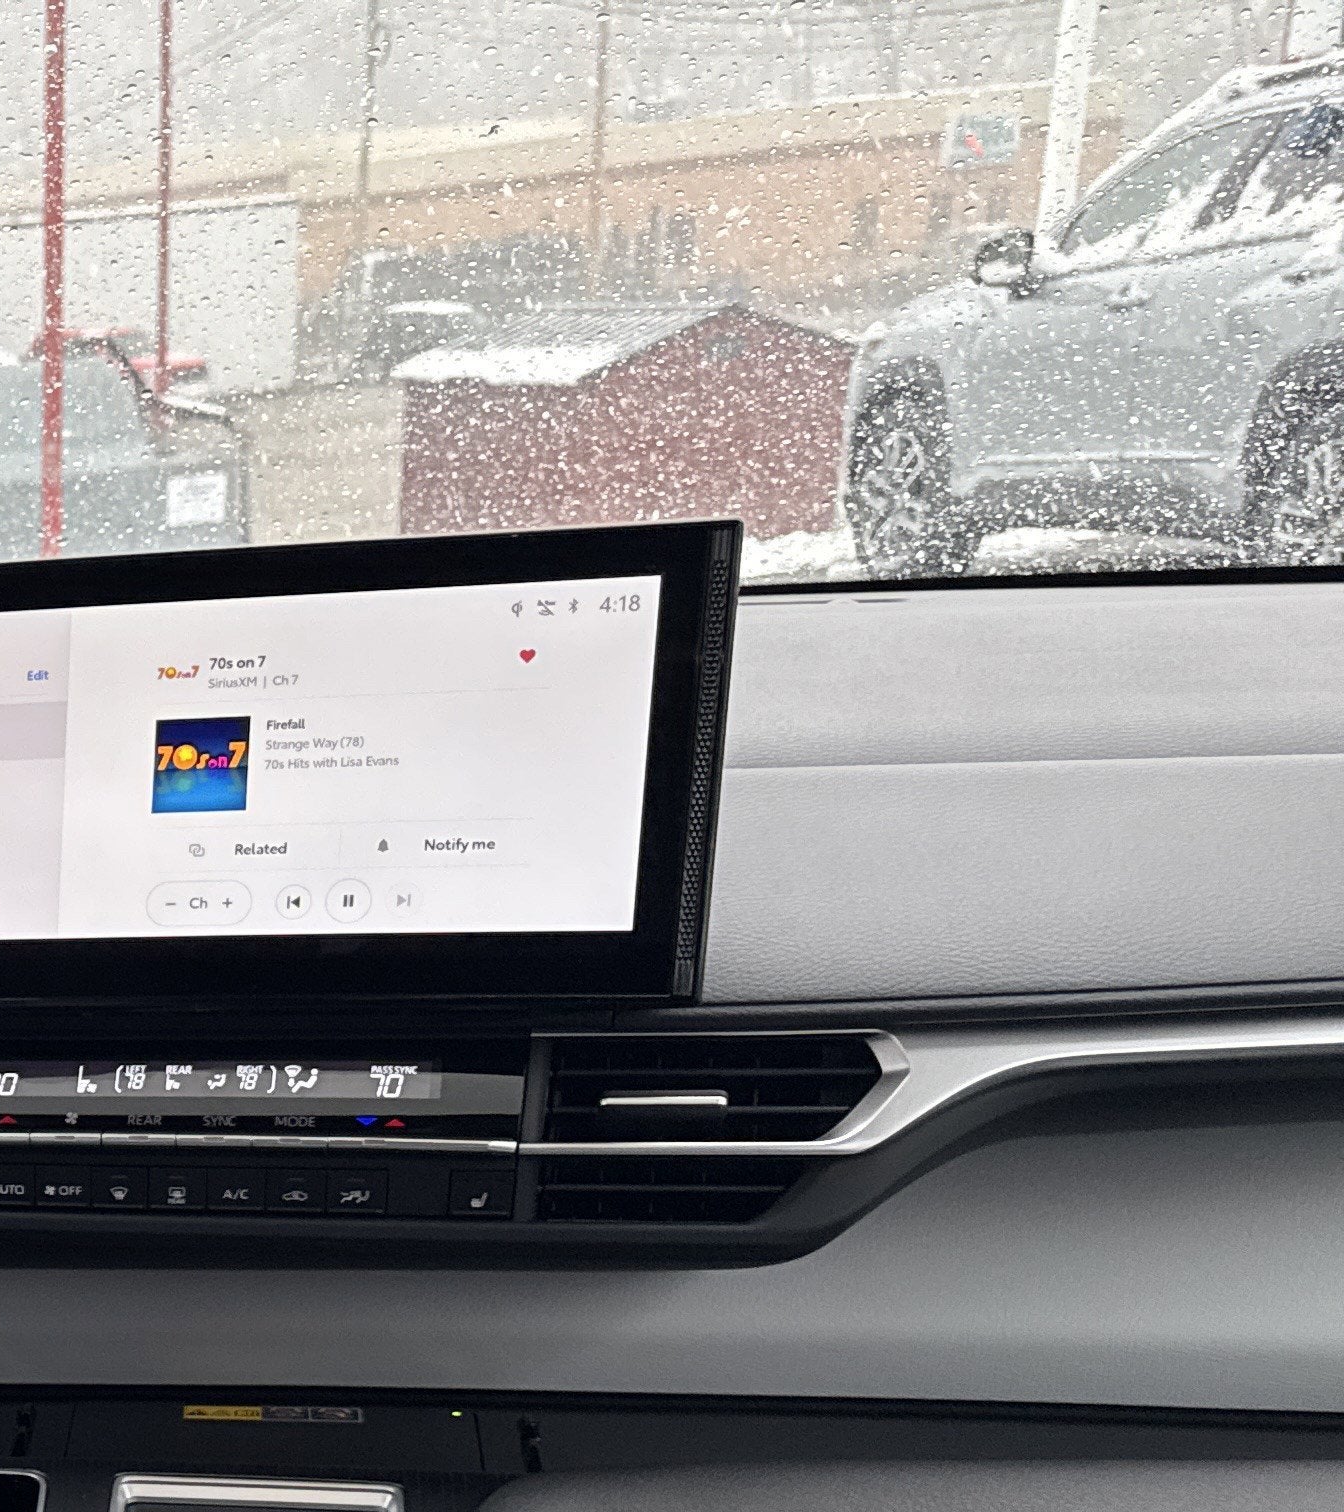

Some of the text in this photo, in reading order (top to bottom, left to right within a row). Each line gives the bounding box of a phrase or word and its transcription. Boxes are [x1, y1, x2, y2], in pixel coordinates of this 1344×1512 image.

[599, 594, 641, 613] 4:18
[209, 655, 267, 670] 70s on 7
[27, 669, 50, 682] Edit
[208, 674, 299, 689] SiriusXM Ch 7
[266, 719, 306, 730] Firefall
[265, 736, 365, 752] Strange Way (78)
[264, 756, 400, 771] 70s Hits with Lisa Evans
[234, 842, 288, 856] Related
[424, 838, 496, 854] Notify me
[189, 896, 208, 909] Ch
[124, 1065, 418, 1075] LEFT REAR RIGHT PASS SYNC
[124, 1073, 146, 1090] 78
[236, 1073, 259, 1090] 78
[369, 1073, 405, 1098] 70
[127, 1115, 316, 1128] REAR SYNC MODE
[58, 1185, 83, 1196] OFF
[222, 1188, 250, 1200] A/C
